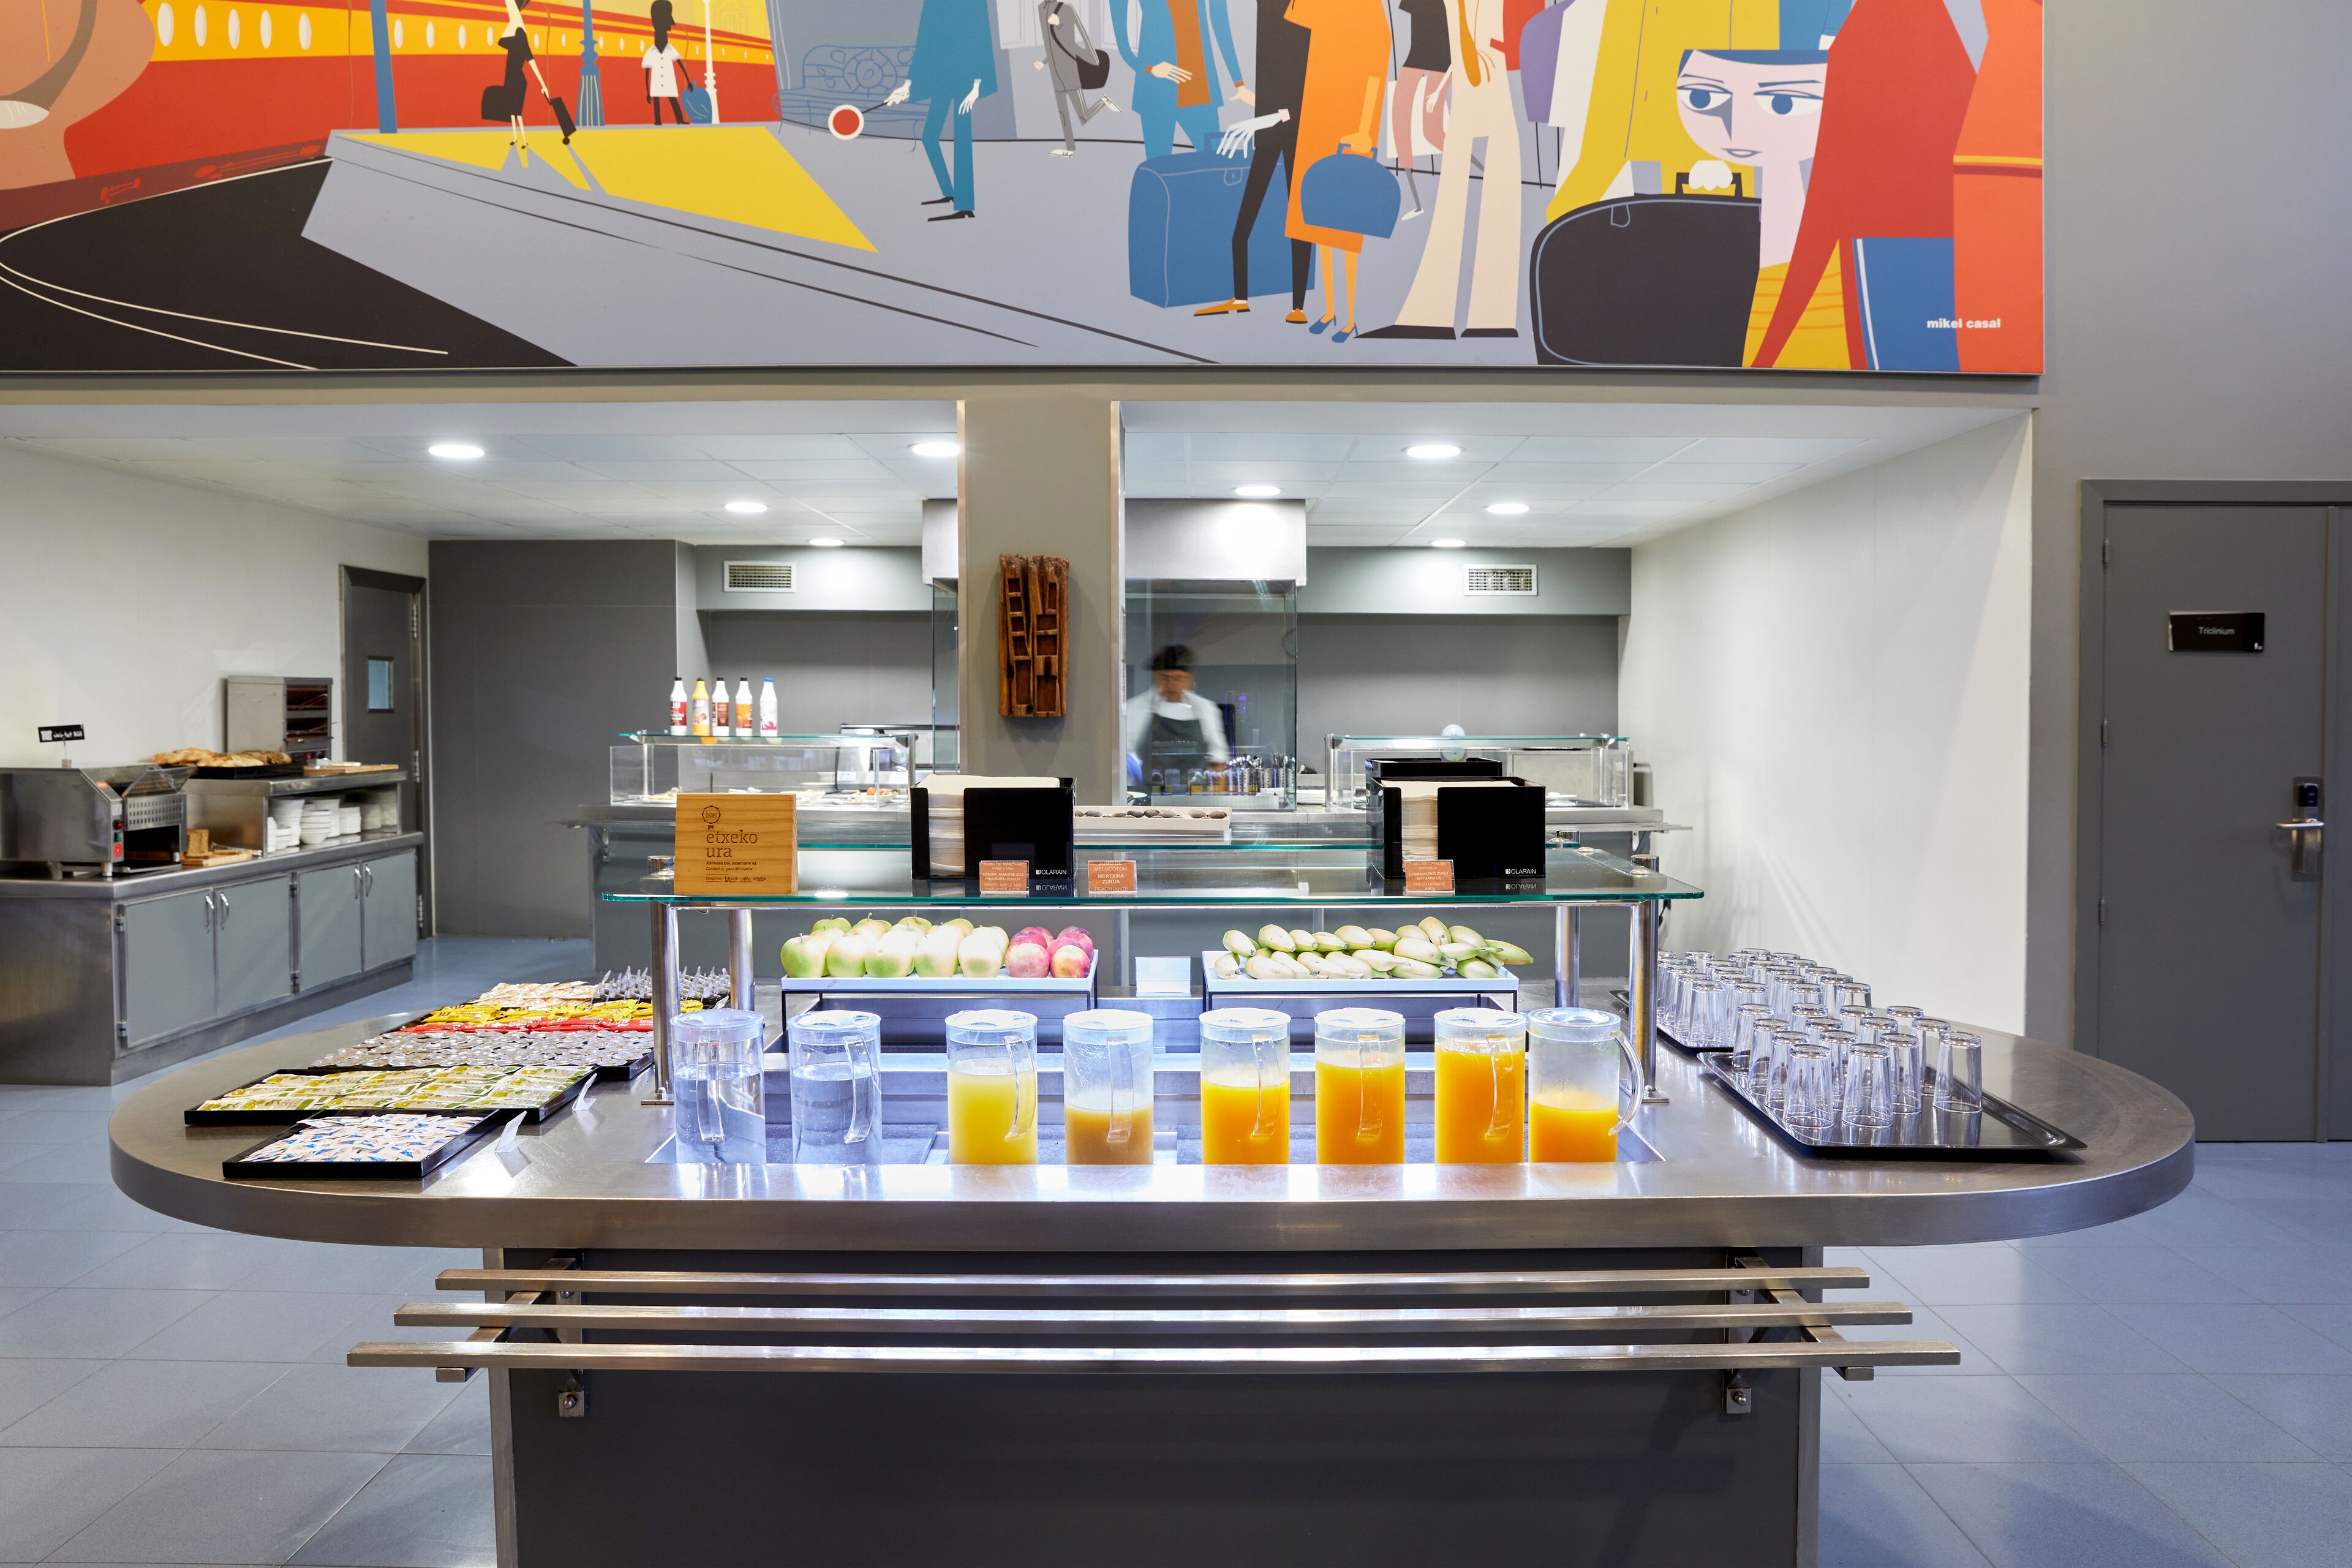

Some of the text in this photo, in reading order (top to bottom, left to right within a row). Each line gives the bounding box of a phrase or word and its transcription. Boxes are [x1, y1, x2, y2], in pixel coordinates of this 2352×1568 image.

[1927, 318, 2001, 328] mikel casal
[706, 829, 758, 844] etxeko
[706, 847, 732, 858] ura
